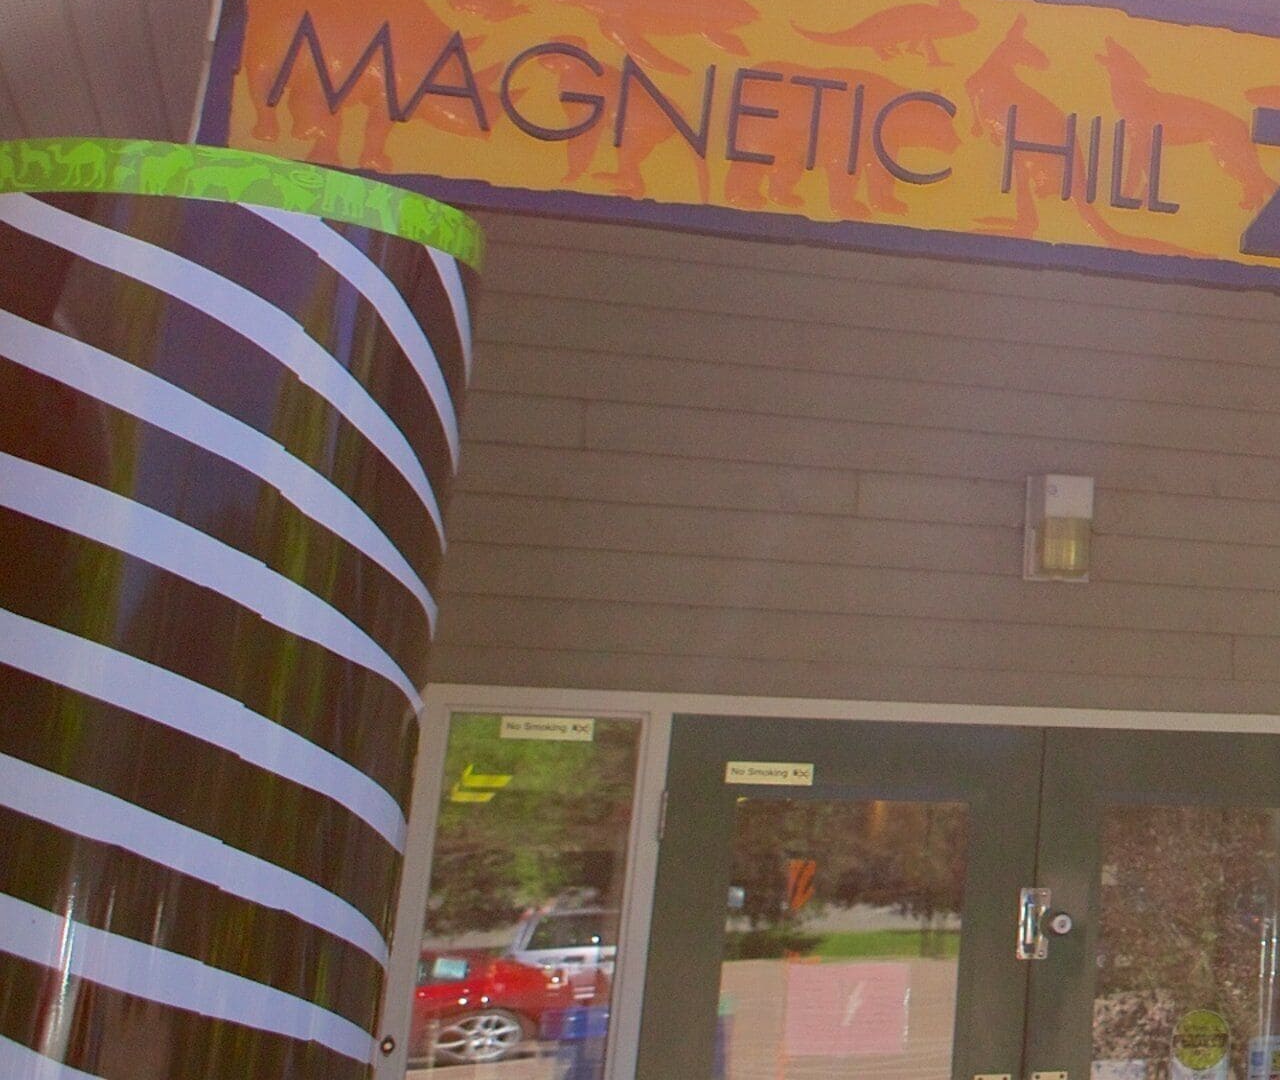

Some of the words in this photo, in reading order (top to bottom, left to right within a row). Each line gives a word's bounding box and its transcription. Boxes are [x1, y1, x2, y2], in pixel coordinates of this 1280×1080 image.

[267, 11, 957, 187] MAGNETIC
[1001, 104, 1180, 214] HILL
[731, 767, 746, 776] No
[748, 767, 788, 778] Smoking
